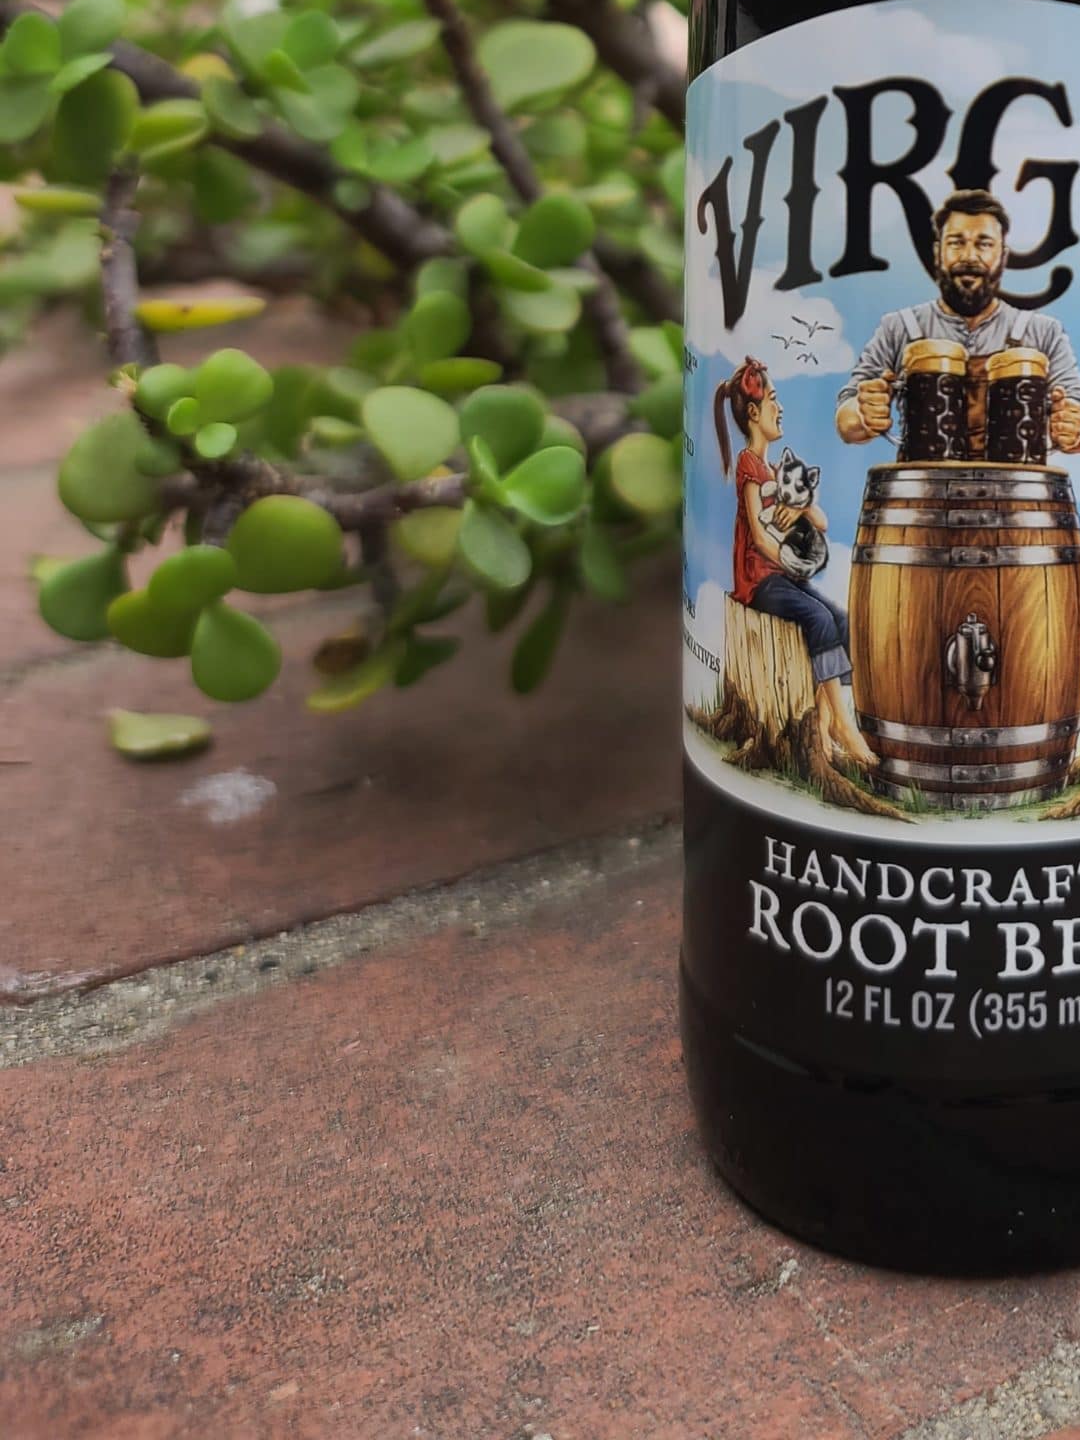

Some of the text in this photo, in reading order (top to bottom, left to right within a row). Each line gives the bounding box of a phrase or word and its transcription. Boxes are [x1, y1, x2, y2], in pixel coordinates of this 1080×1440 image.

[748, 879, 971, 979] ROOT
[825, 977, 854, 1018] 12
[864, 984, 901, 1026] FL
[911, 990, 956, 1031] OZ
[969, 988, 1048, 1039] (355
